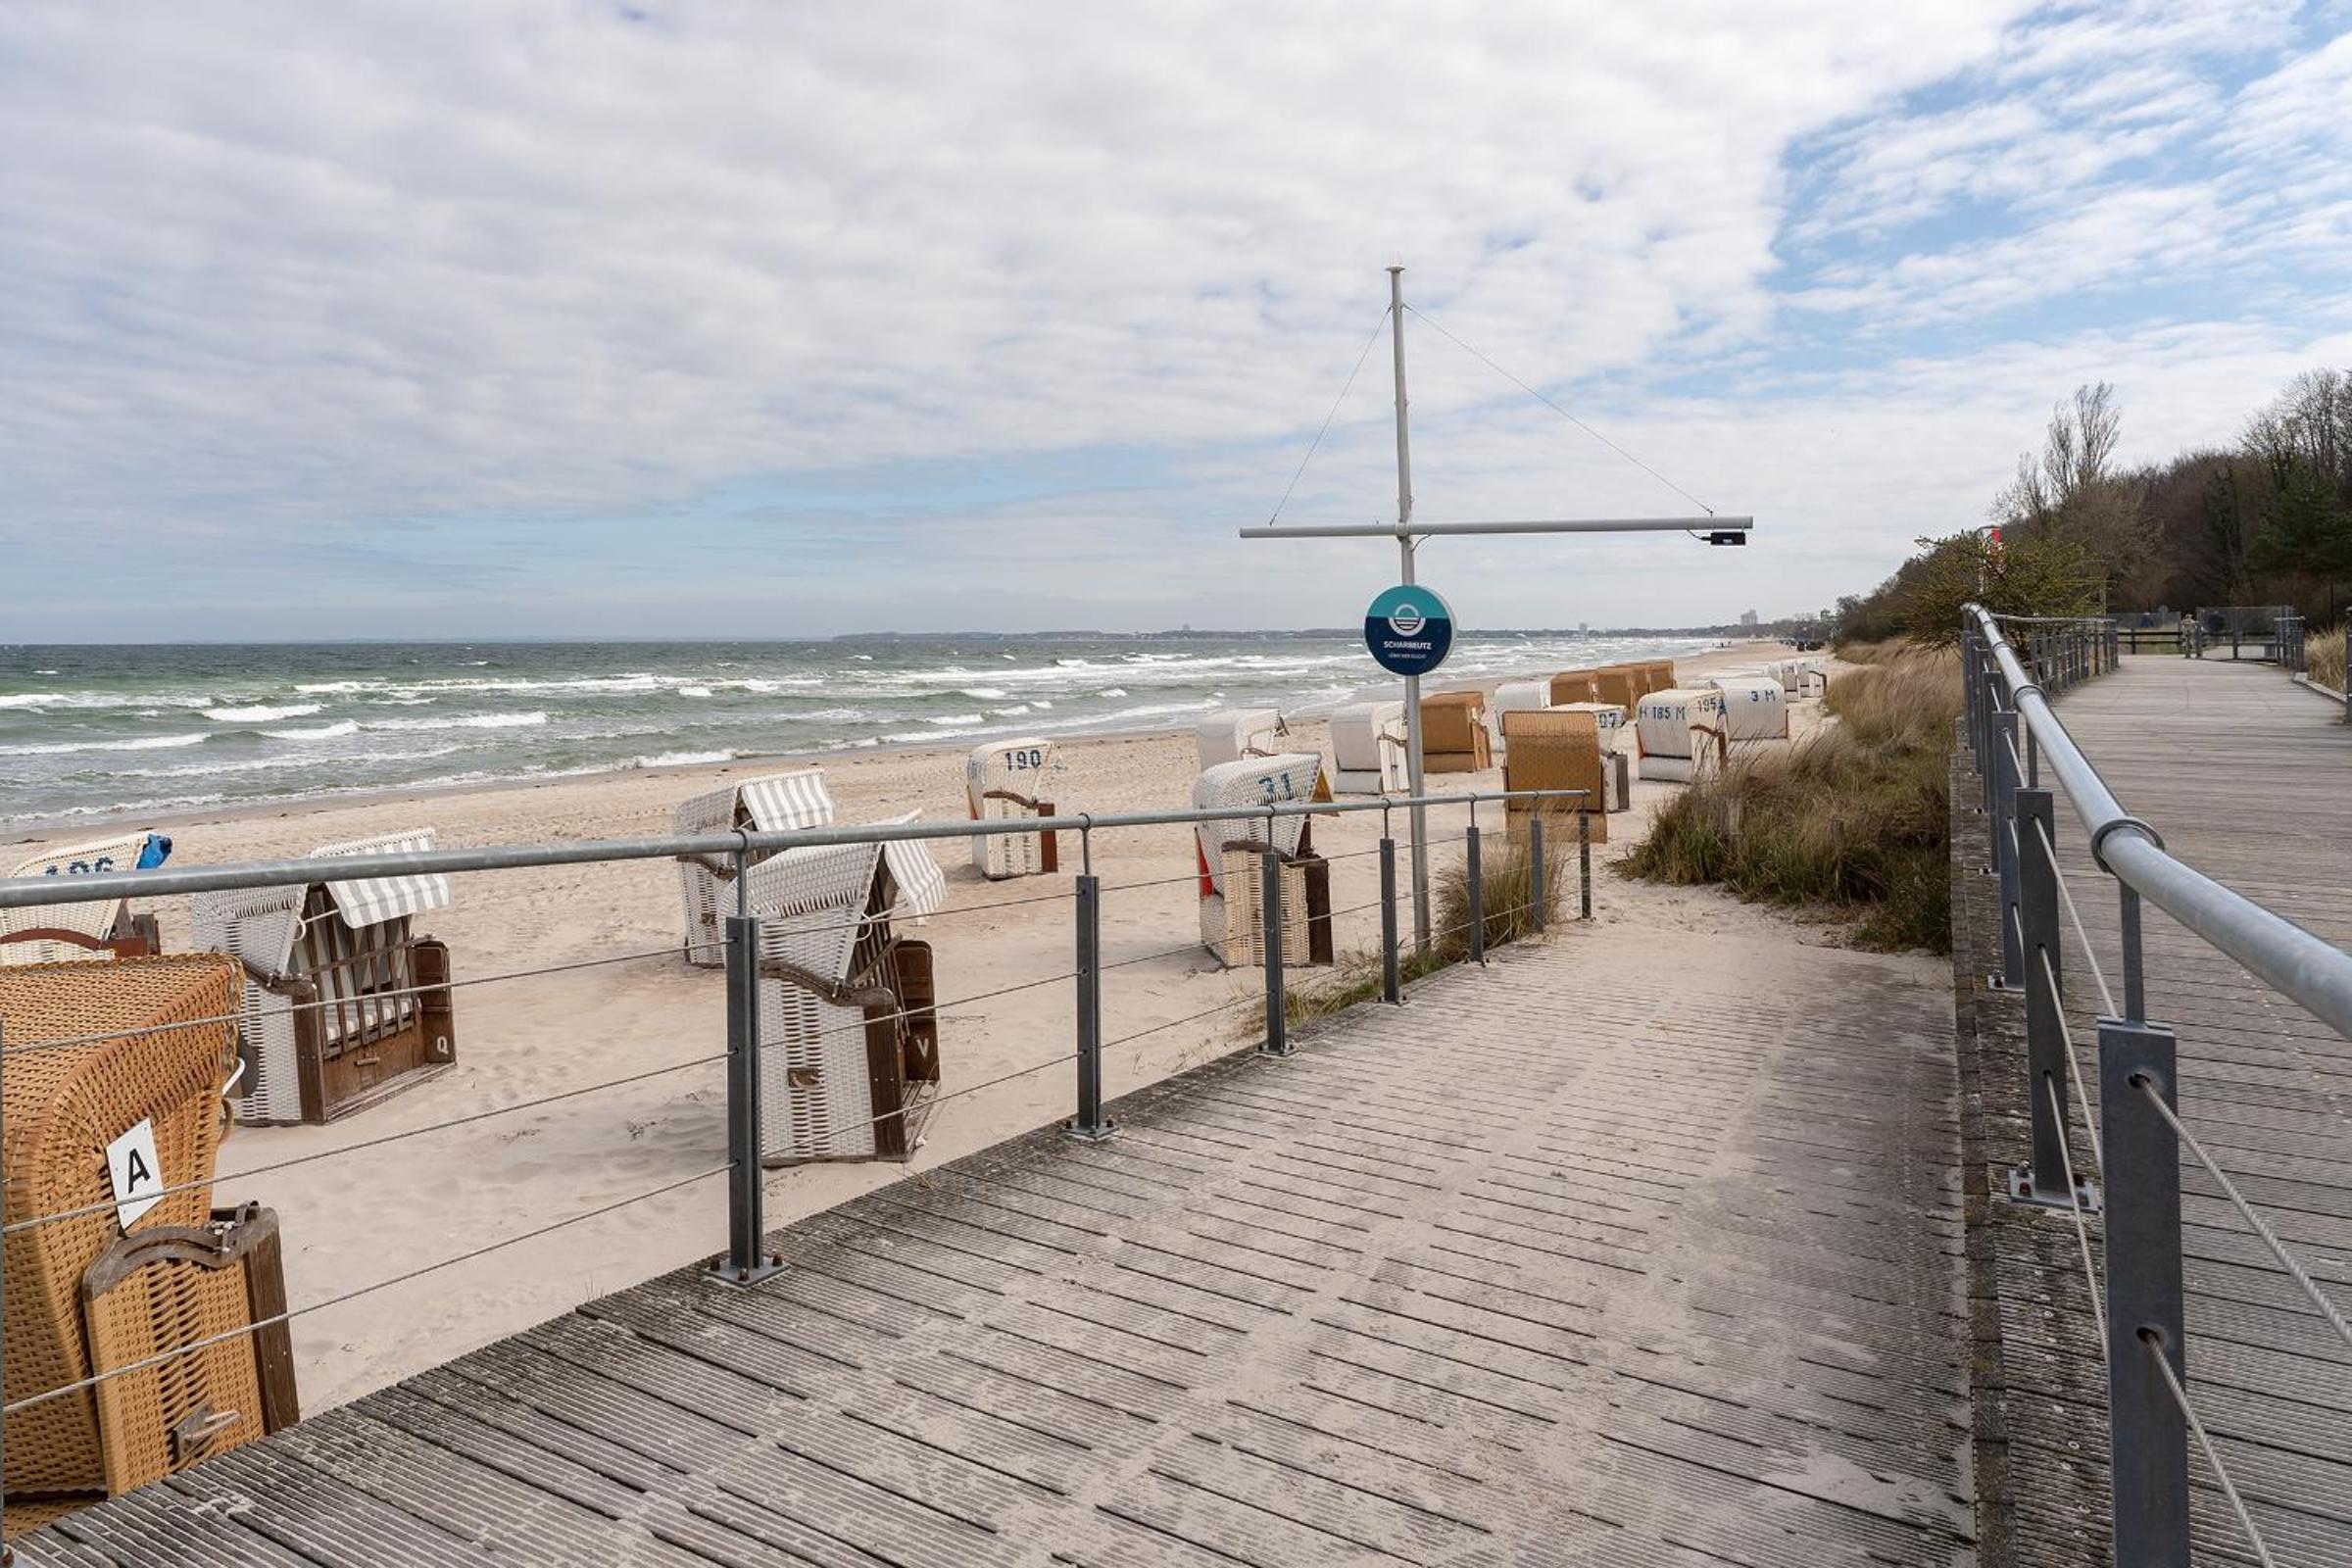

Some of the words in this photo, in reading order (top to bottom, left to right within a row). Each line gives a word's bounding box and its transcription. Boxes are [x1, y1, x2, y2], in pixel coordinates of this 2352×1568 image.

[1765, 690, 1776, 702] M
[1653, 707, 1670, 719] 185
[1676, 707, 1686, 719] M
[1005, 750, 1041, 770] 190
[437, 1036, 449, 1054] Q
[916, 1038, 929, 1057] V
[128, 1148, 151, 1194] A
